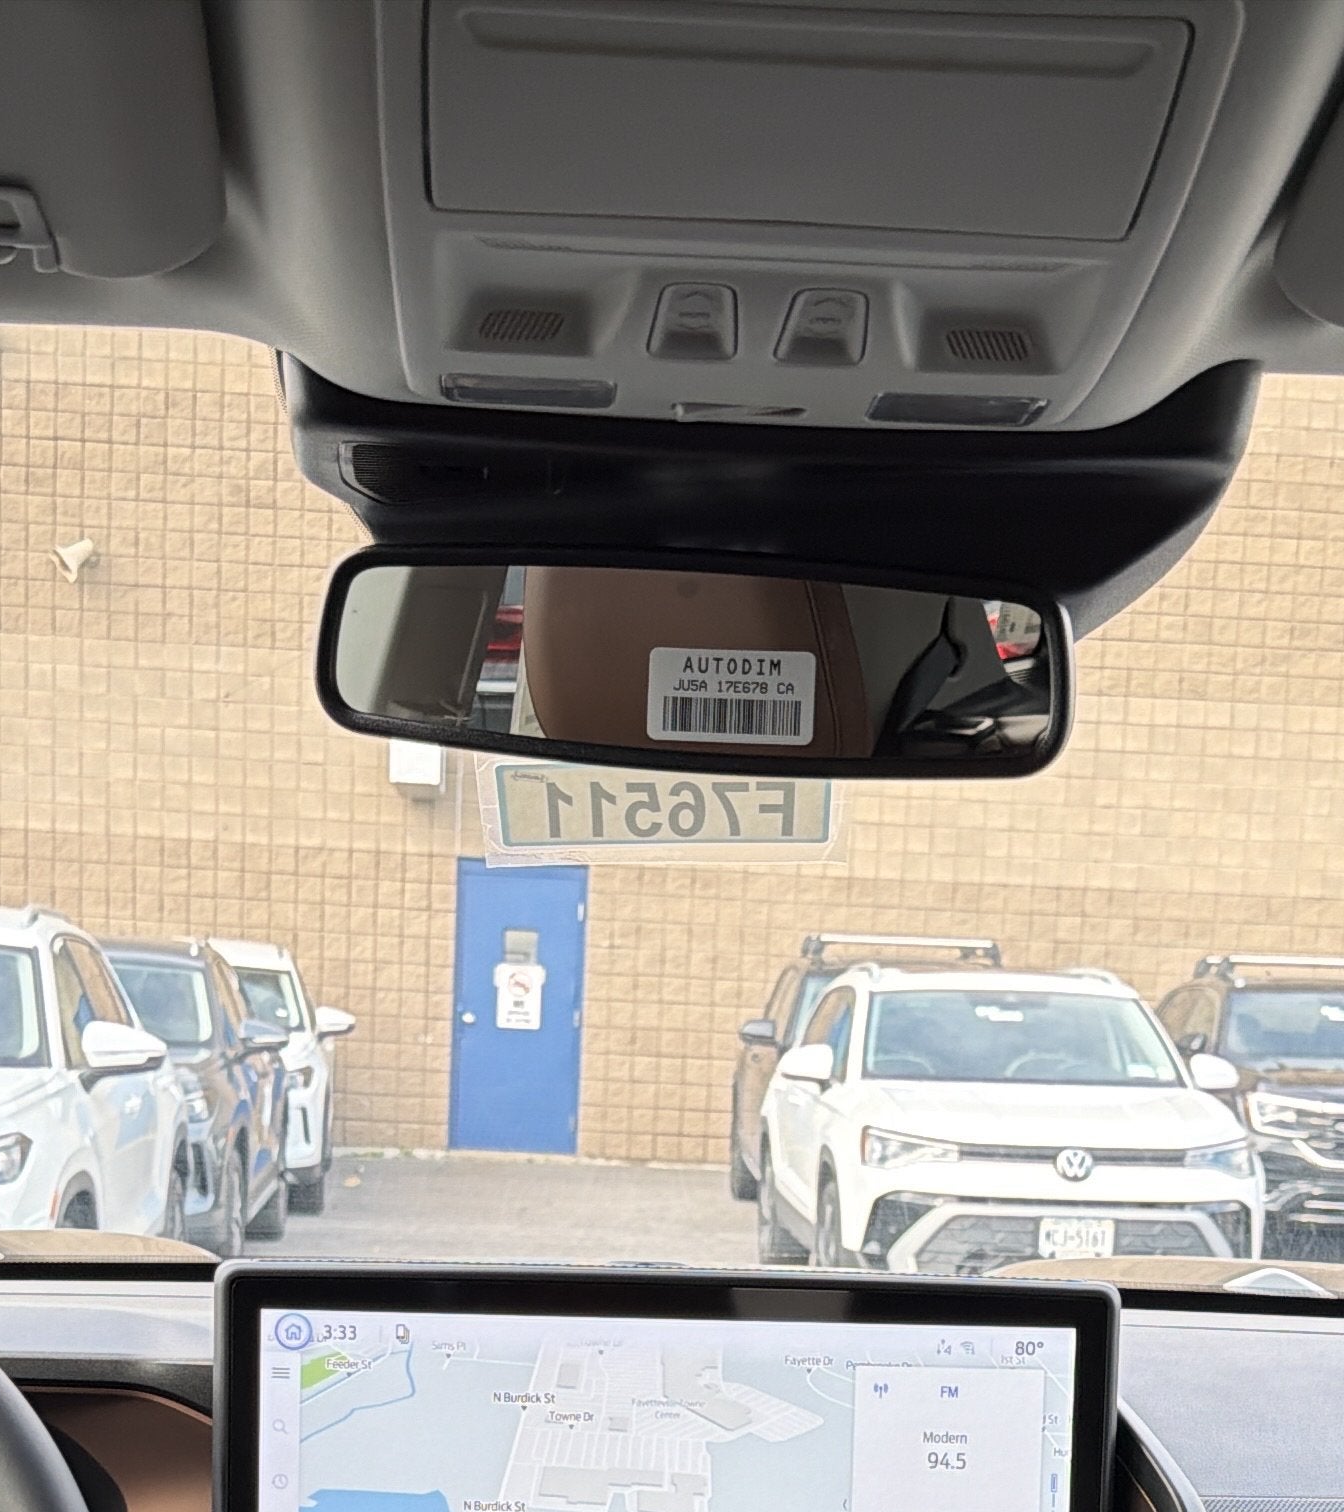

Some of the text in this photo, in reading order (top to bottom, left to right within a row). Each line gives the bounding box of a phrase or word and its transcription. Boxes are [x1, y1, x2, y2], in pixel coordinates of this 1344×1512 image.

[682, 655, 783, 677] AUTODIM
[717, 680, 769, 695] 17E678
[776, 682, 795, 696] CA
[323, 1324, 357, 1341] 3:33
[1014, 1340, 1044, 1356] 80°
[326, 1358, 372, 1371] Feeder St
[784, 1355, 822, 1367] Fayette
[493, 1391, 556, 1405] N Burdick St
[940, 1385, 959, 1399] FM
[548, 1410, 595, 1423] Towne Dr
[922, 1430, 968, 1446] Modern
[926, 1451, 968, 1471] 94.5
[463, 1500, 526, 1512] N Burdick St
